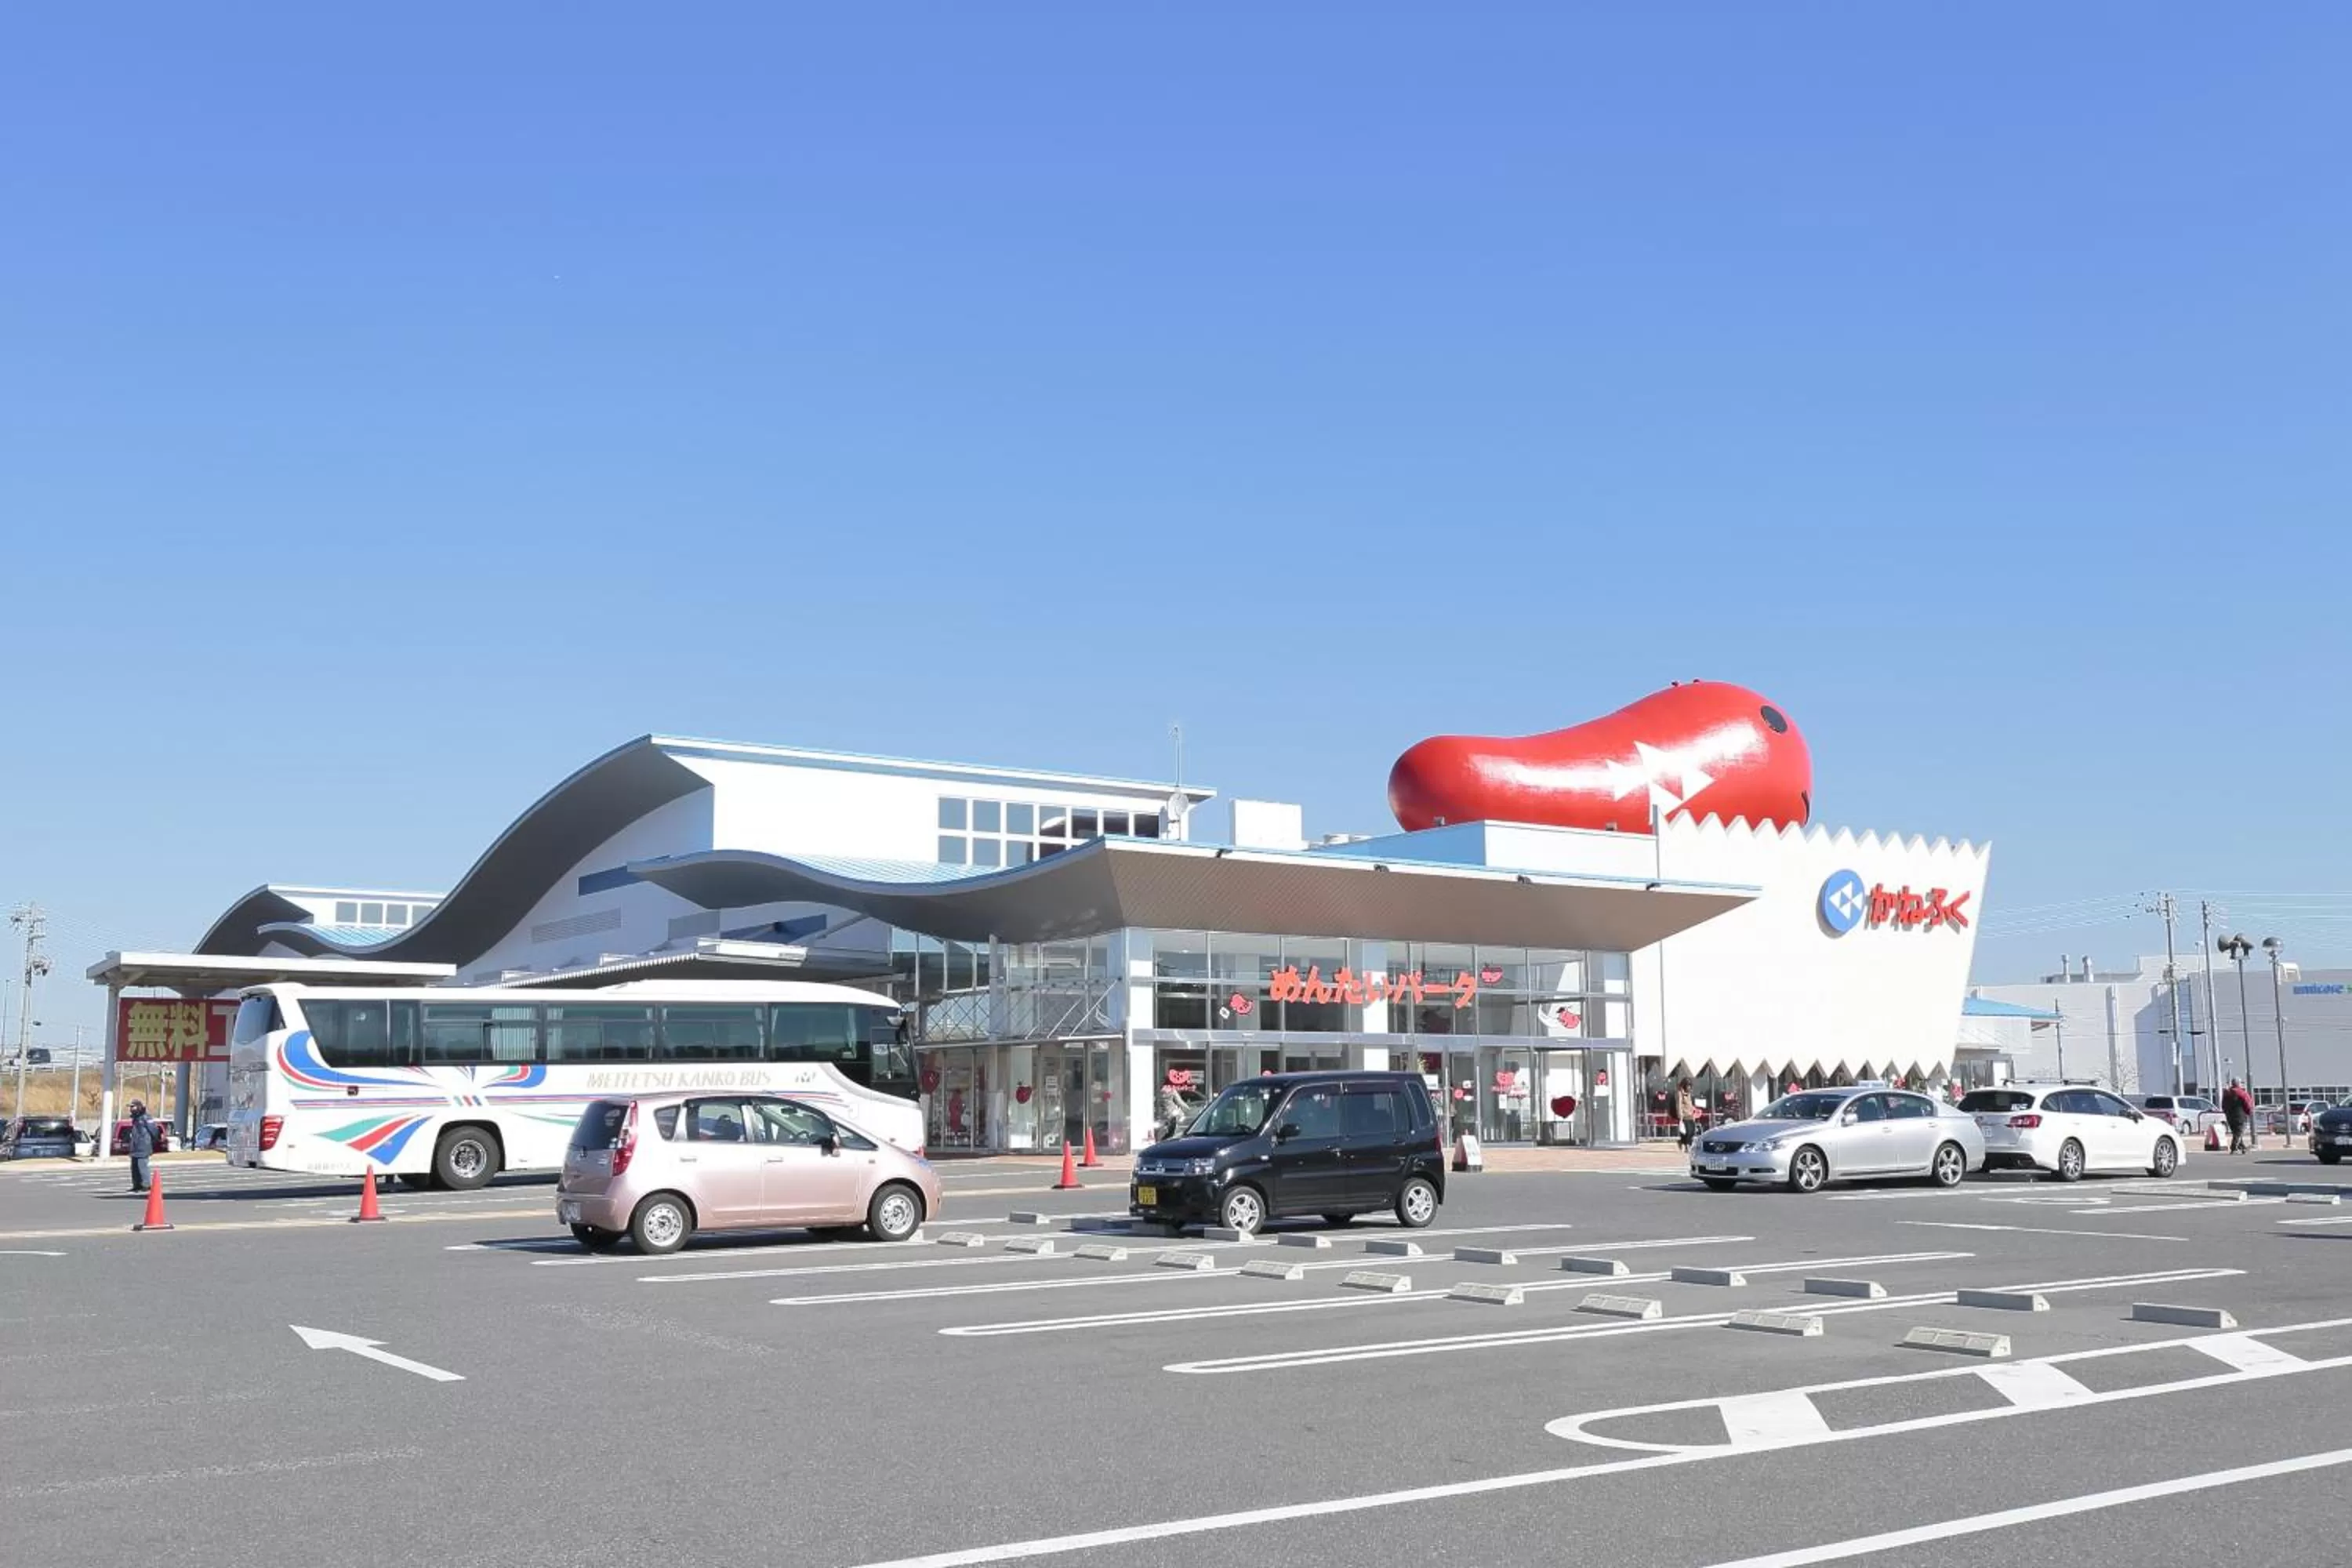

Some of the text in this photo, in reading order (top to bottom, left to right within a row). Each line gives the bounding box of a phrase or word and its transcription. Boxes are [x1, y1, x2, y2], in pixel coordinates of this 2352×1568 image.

[1871, 883, 1970, 927] かねふく
[1270, 965, 1475, 1008] めんたいパーク
[586, 1069, 771, 1088] MEITETSU KANKO BUS
